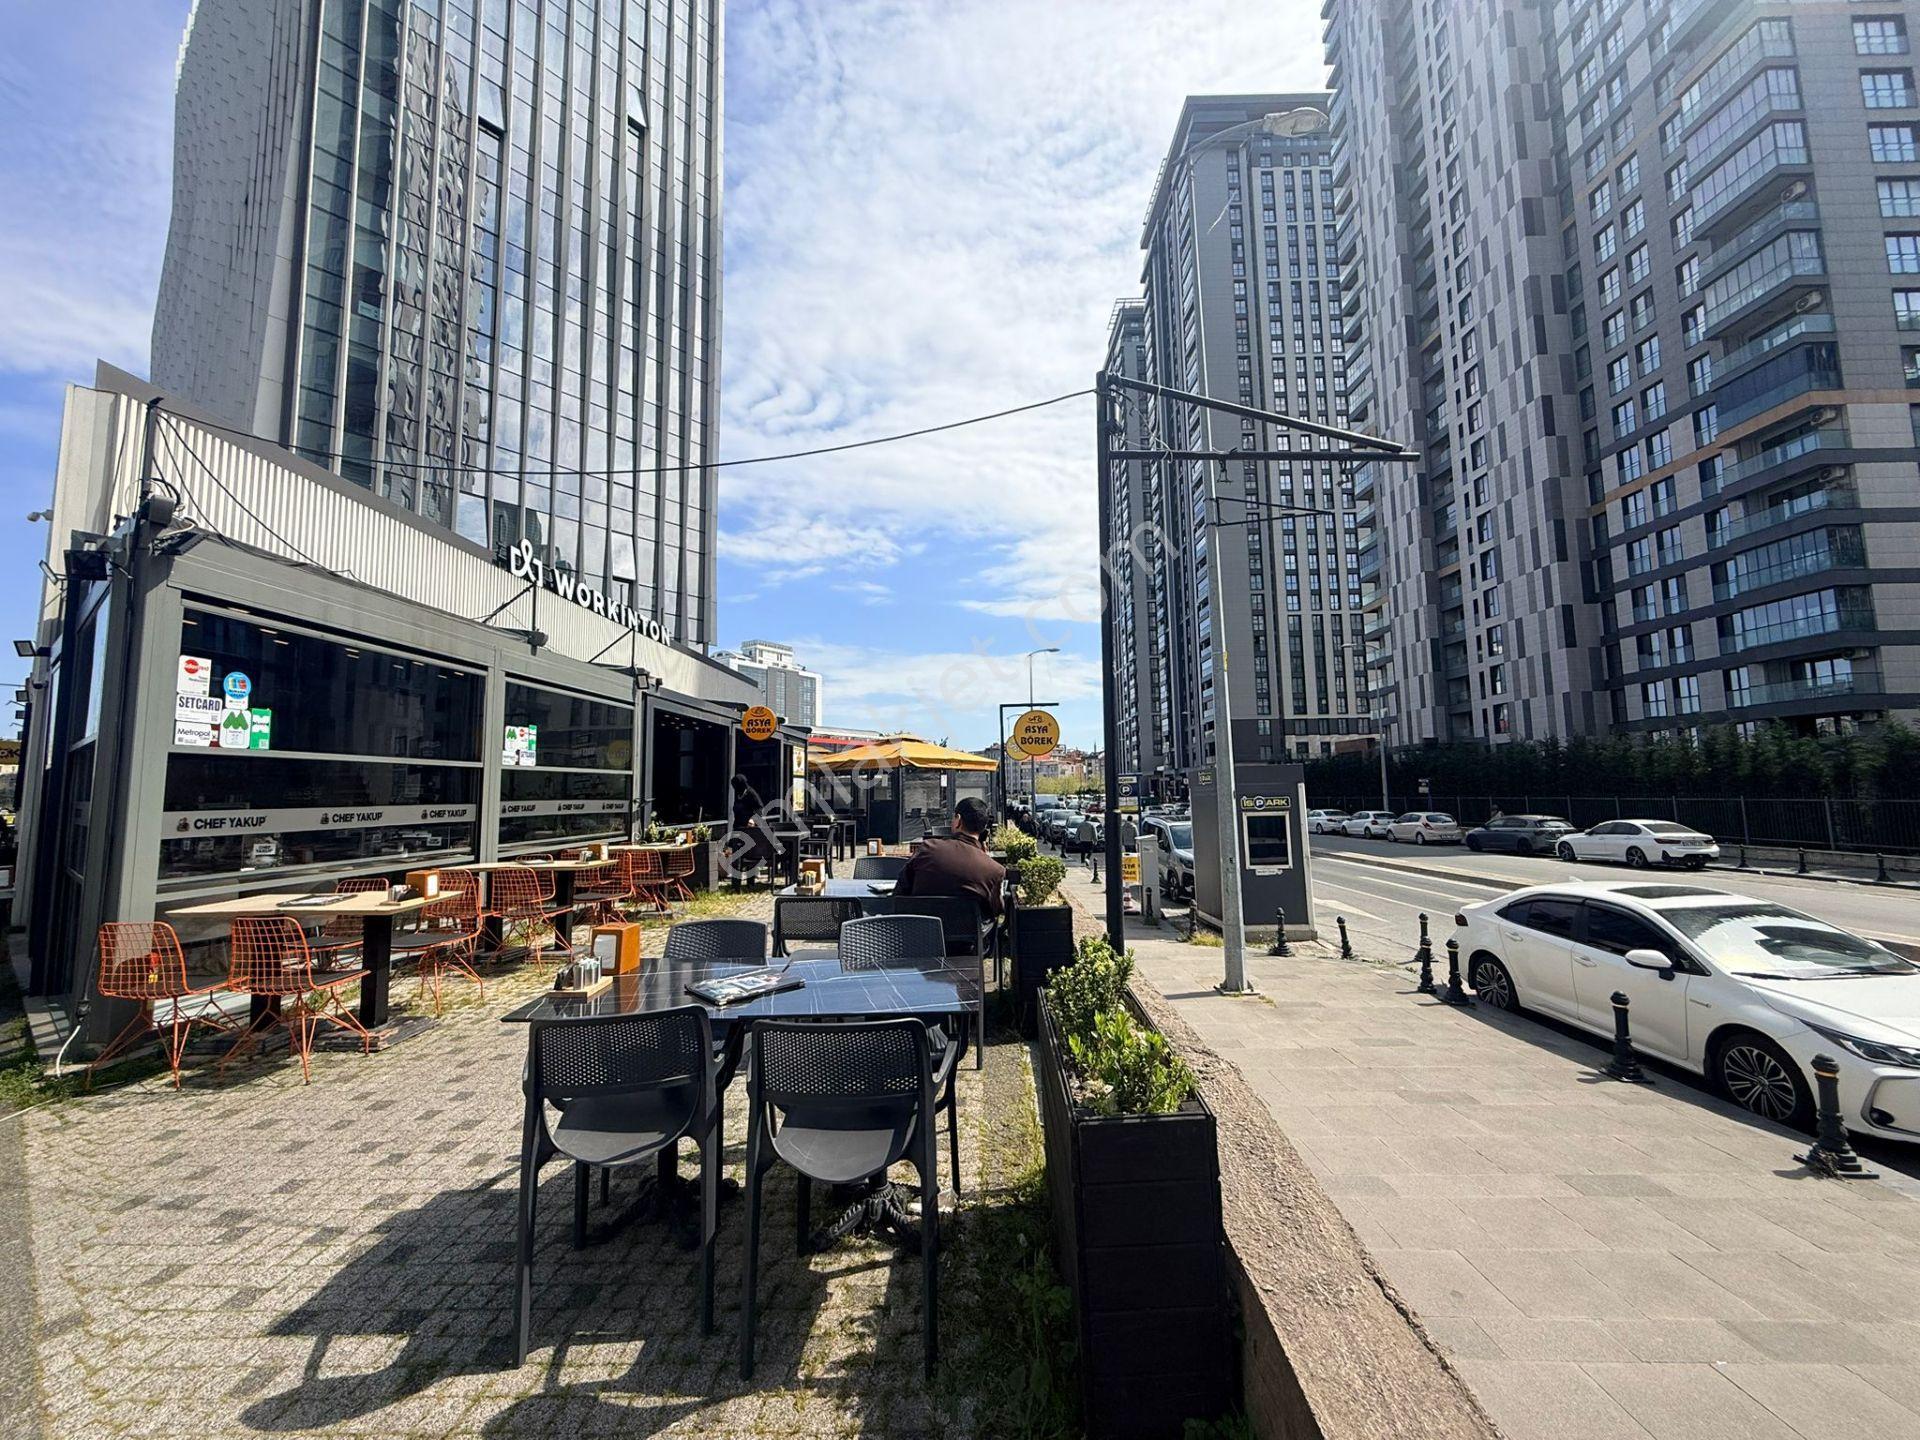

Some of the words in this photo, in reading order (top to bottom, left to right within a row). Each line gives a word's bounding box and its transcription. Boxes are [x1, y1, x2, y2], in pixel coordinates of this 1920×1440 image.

[554, 569, 671, 647] WORKINTON
[178, 696, 220, 711] SETCARD
[747, 718, 771, 727] ASYA
[177, 727, 211, 737] Metropol
[1024, 725, 1048, 734] ASYA
[332, 812, 355, 823] CHEF
[356, 812, 383, 822] YAKUP
[429, 810, 447, 818] CHEF
[447, 809, 467, 817] YAKUP
[194, 817, 227, 830] CHEF
[229, 816, 266, 828] YAKUP
